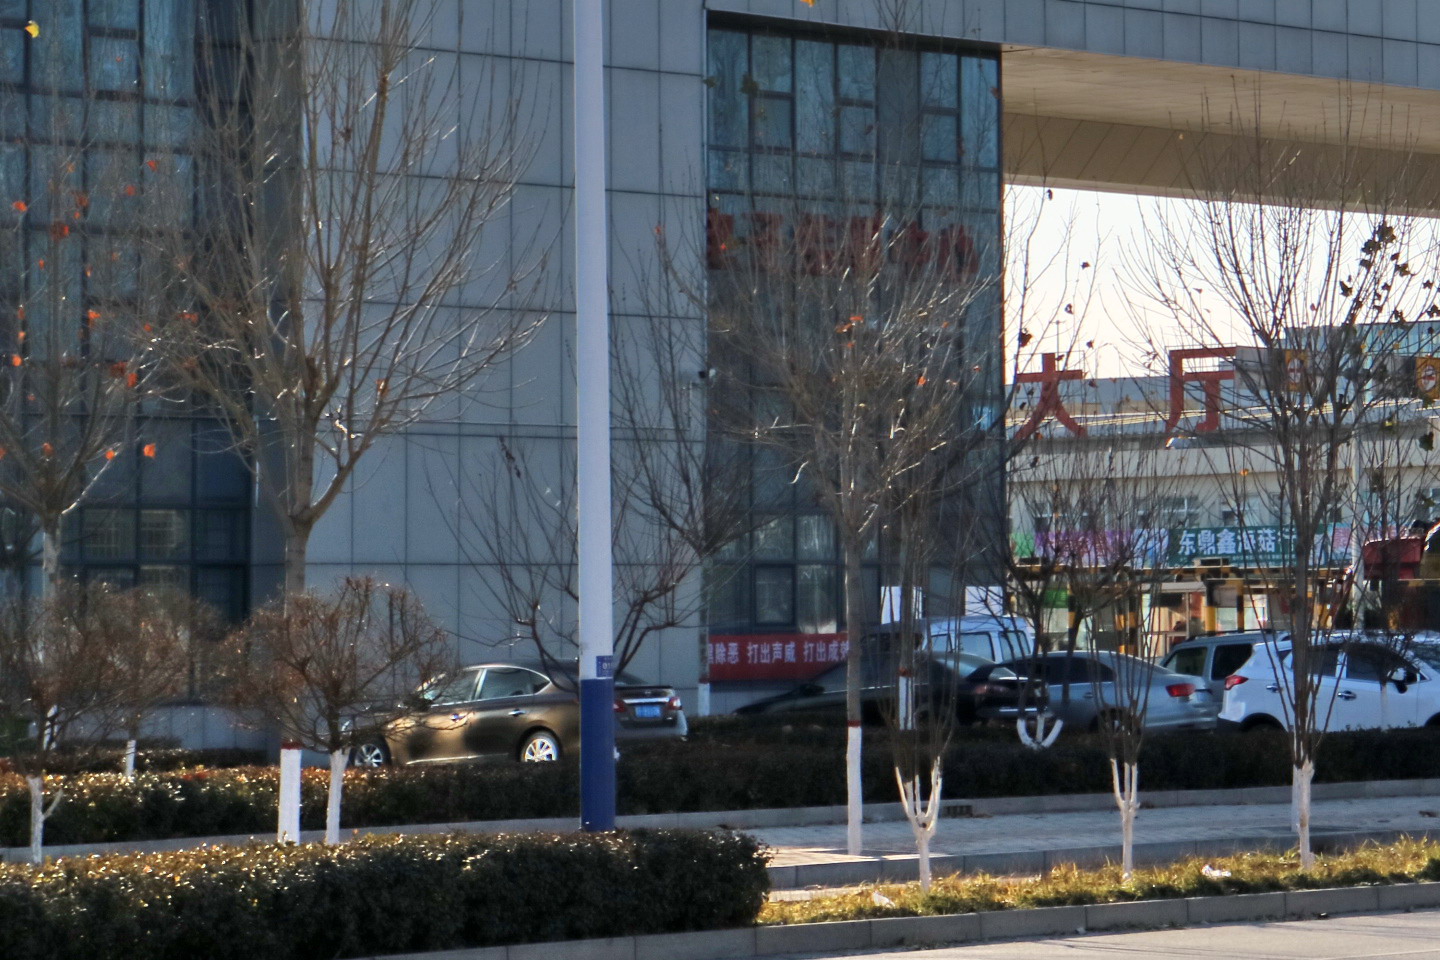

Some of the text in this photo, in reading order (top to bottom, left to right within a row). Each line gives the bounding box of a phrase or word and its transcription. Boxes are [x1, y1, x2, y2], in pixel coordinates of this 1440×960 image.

[1014, 346, 1236, 440] 大厅
[747, 642, 796, 664] 打出声威
